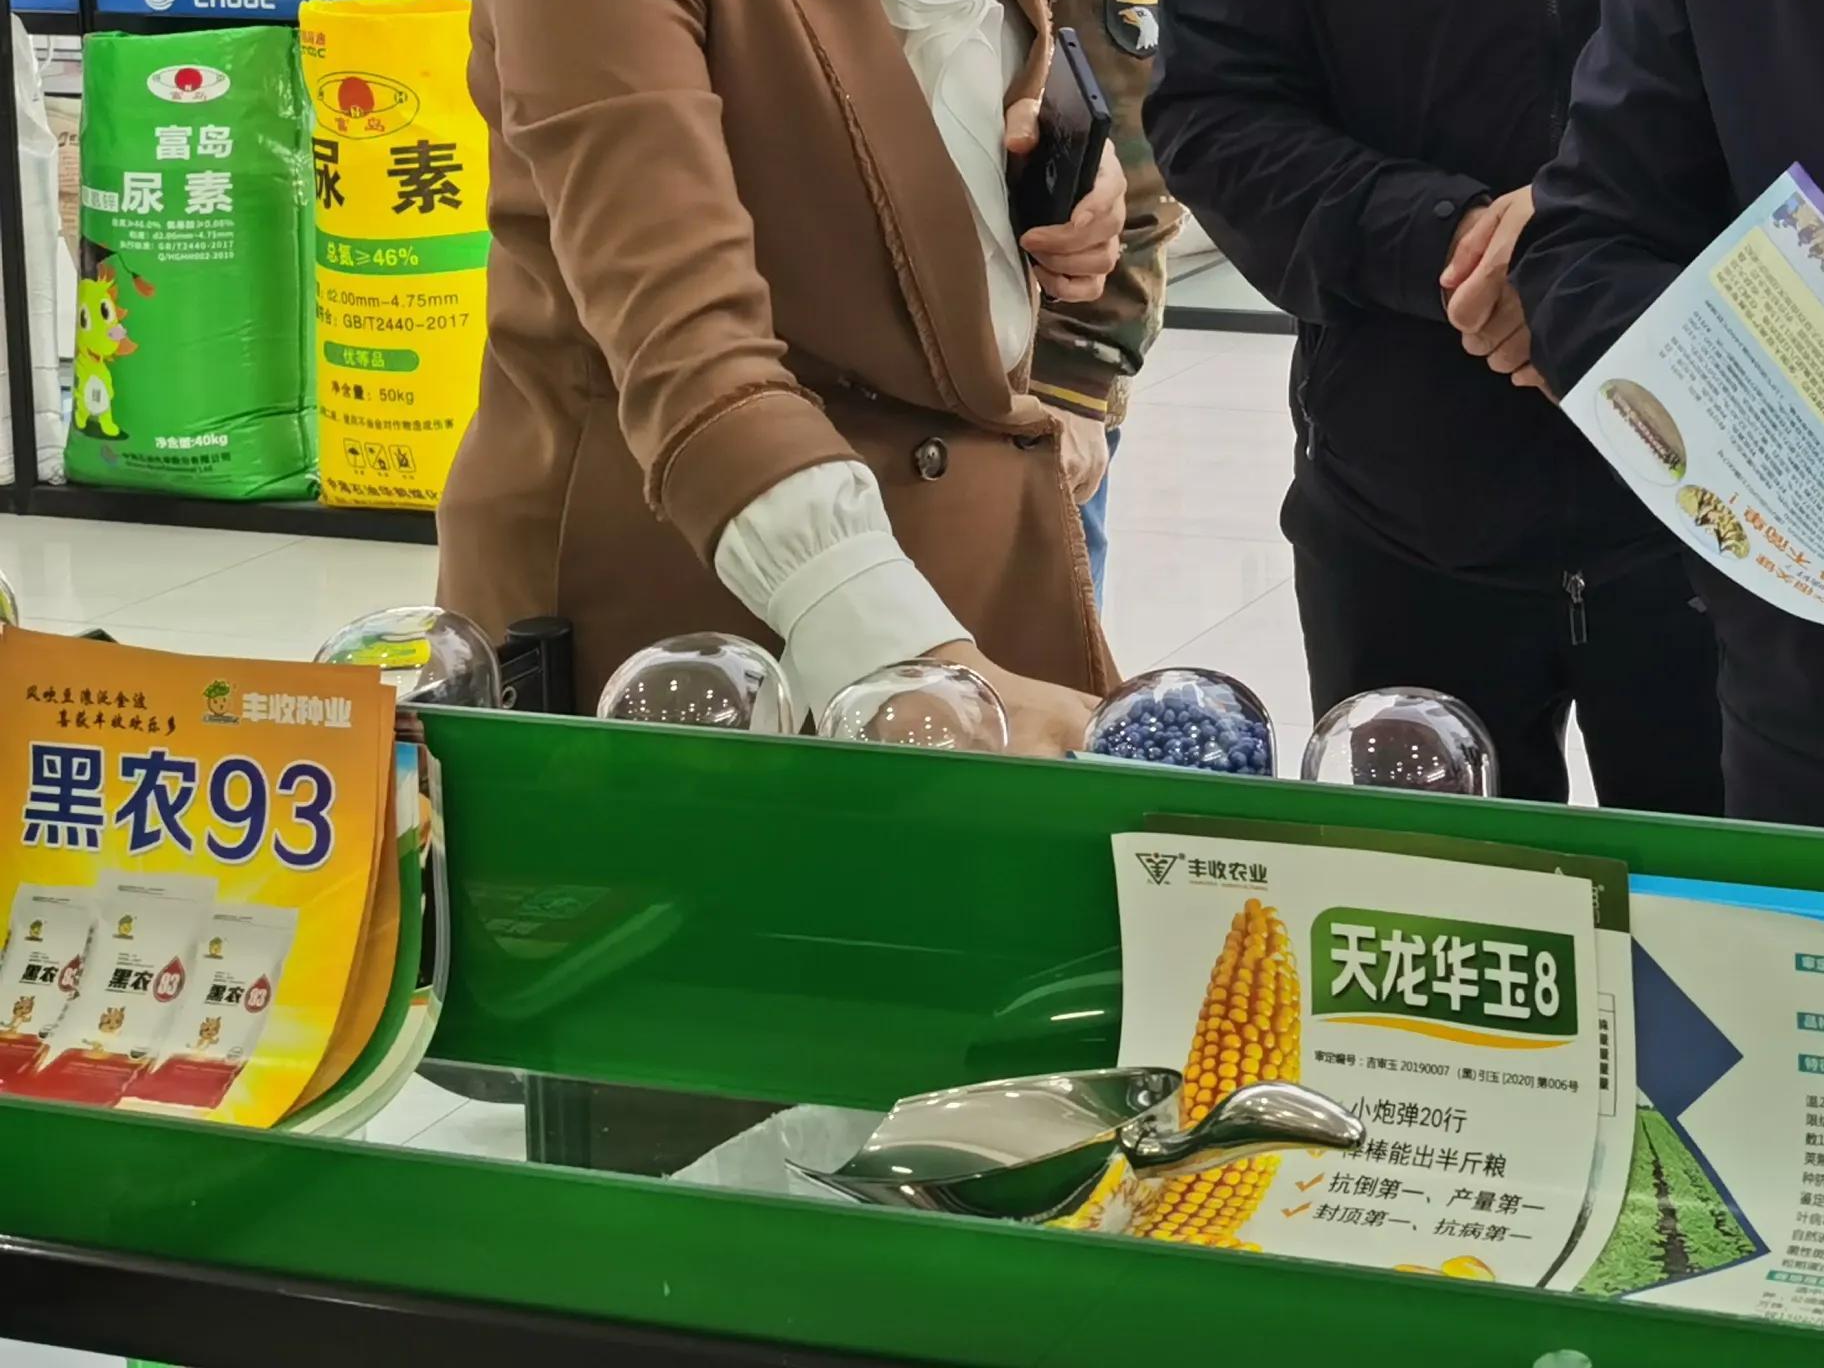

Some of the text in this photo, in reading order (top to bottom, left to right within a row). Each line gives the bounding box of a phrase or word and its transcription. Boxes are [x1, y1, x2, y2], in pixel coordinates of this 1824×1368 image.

[155, 124, 234, 160] 富岛
[121, 170, 233, 214] 尿素
[312, 137, 464, 215] 尿素
[326, 241, 419, 267] 总氮≥46%
[343, 347, 385, 368] 优等品
[242, 691, 353, 729] 丰收种业
[22, 741, 336, 871] 黑农93
[1188, 858, 1269, 884] 丰收农业
[22, 964, 59, 983] 黑农
[108, 968, 154, 991] 黑农
[1330, 922, 1561, 1020] 天龙华玉8
[205, 984, 245, 1004] 黑农
[1350, 1096, 1468, 1134] 小炮弹20行
[1328, 1172, 1546, 1216] 抗倒第一、产量第一
[1312, 1202, 1533, 1243] 封顶第一、抗病第一
